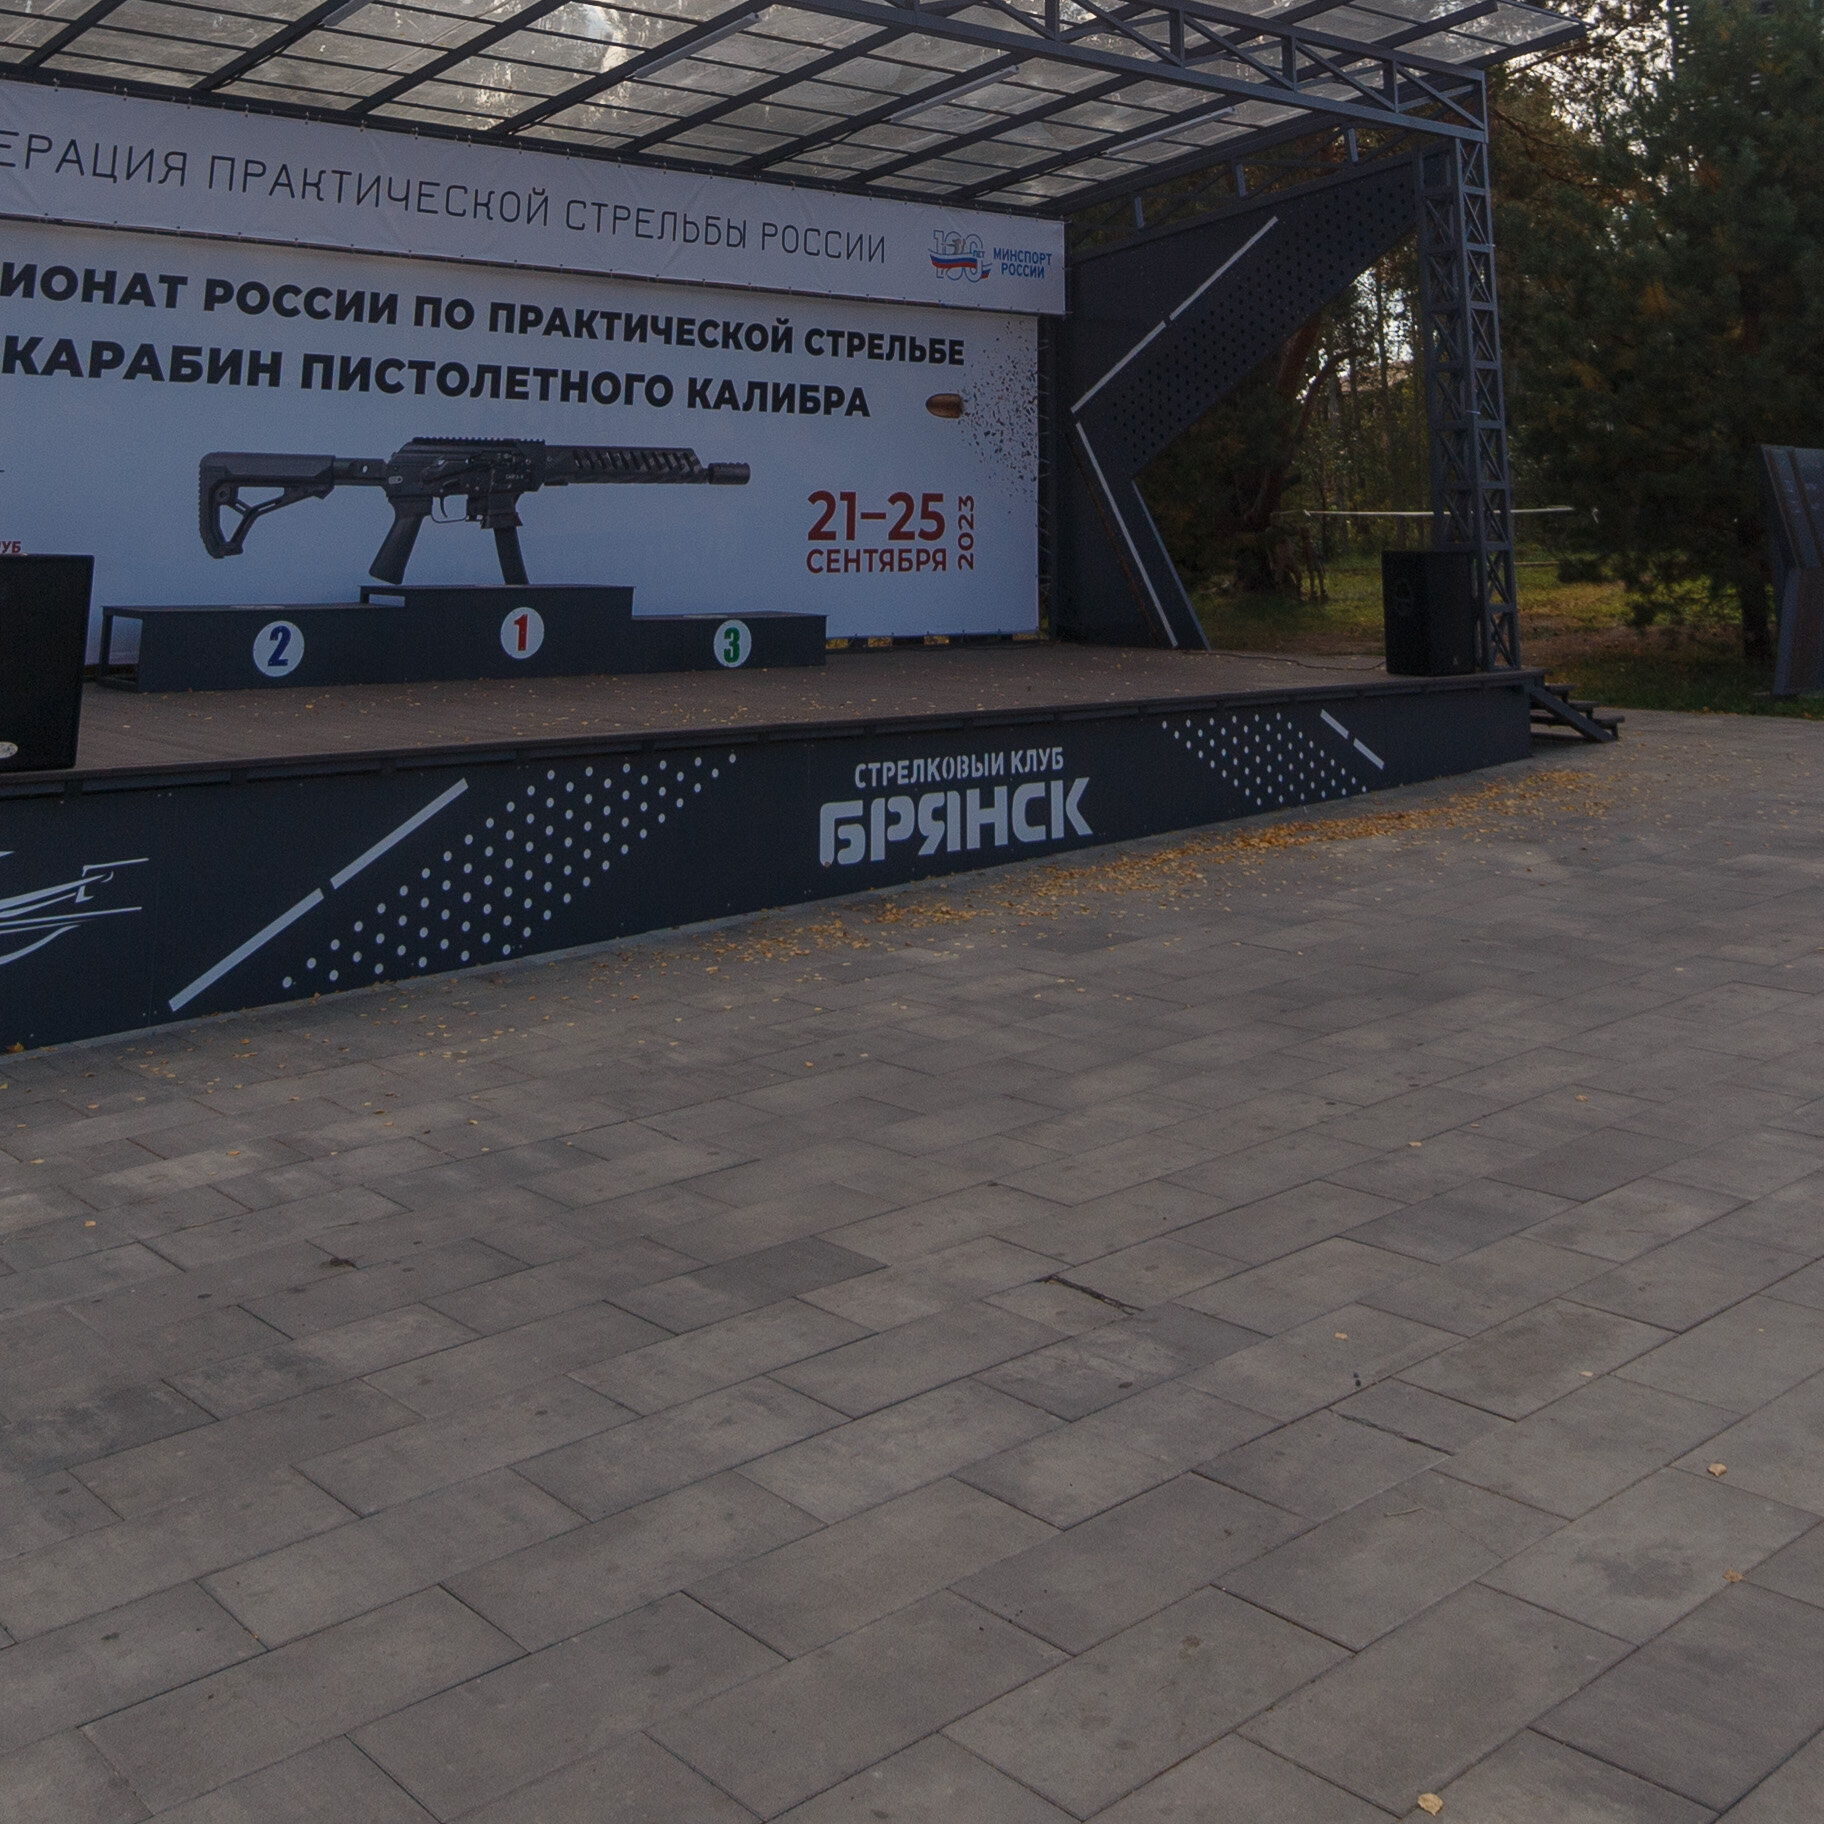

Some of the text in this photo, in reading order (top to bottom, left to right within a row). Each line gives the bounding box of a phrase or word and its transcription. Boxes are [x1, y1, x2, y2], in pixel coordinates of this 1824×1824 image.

[208, 154, 550, 227] ПРАКТИЧЕСКОЙ
[565, 199, 747, 249] СТРЕЛЬБЫ
[761, 222, 886, 264] РОССИИ
[992, 247, 1053, 266] МИНСПОРТ
[1001, 262, 1046, 279] РОССИИ
[203, 278, 399, 325] РОССИИ
[413, 295, 475, 330] ПО
[488, 301, 794, 354] ПРАКТИЧЕСКОЙ
[804, 328, 965, 366] СТРЕЛЬБЕ
[1, 334, 871, 418] КАРАБИН ПИСТОЛЕТНОГО КАЛИБРА
[807, 489, 946, 542] 21–25
[957, 494, 975, 571] 2023
[806, 547, 947, 574] СЕНТЯБРЯ
[267, 625, 292, 667] 2
[513, 613, 529, 652] 1
[723, 626, 741, 664] 3
[1010, 746, 1064, 774] КЛУБ
[819, 776, 1094, 867] БРЯНСК
